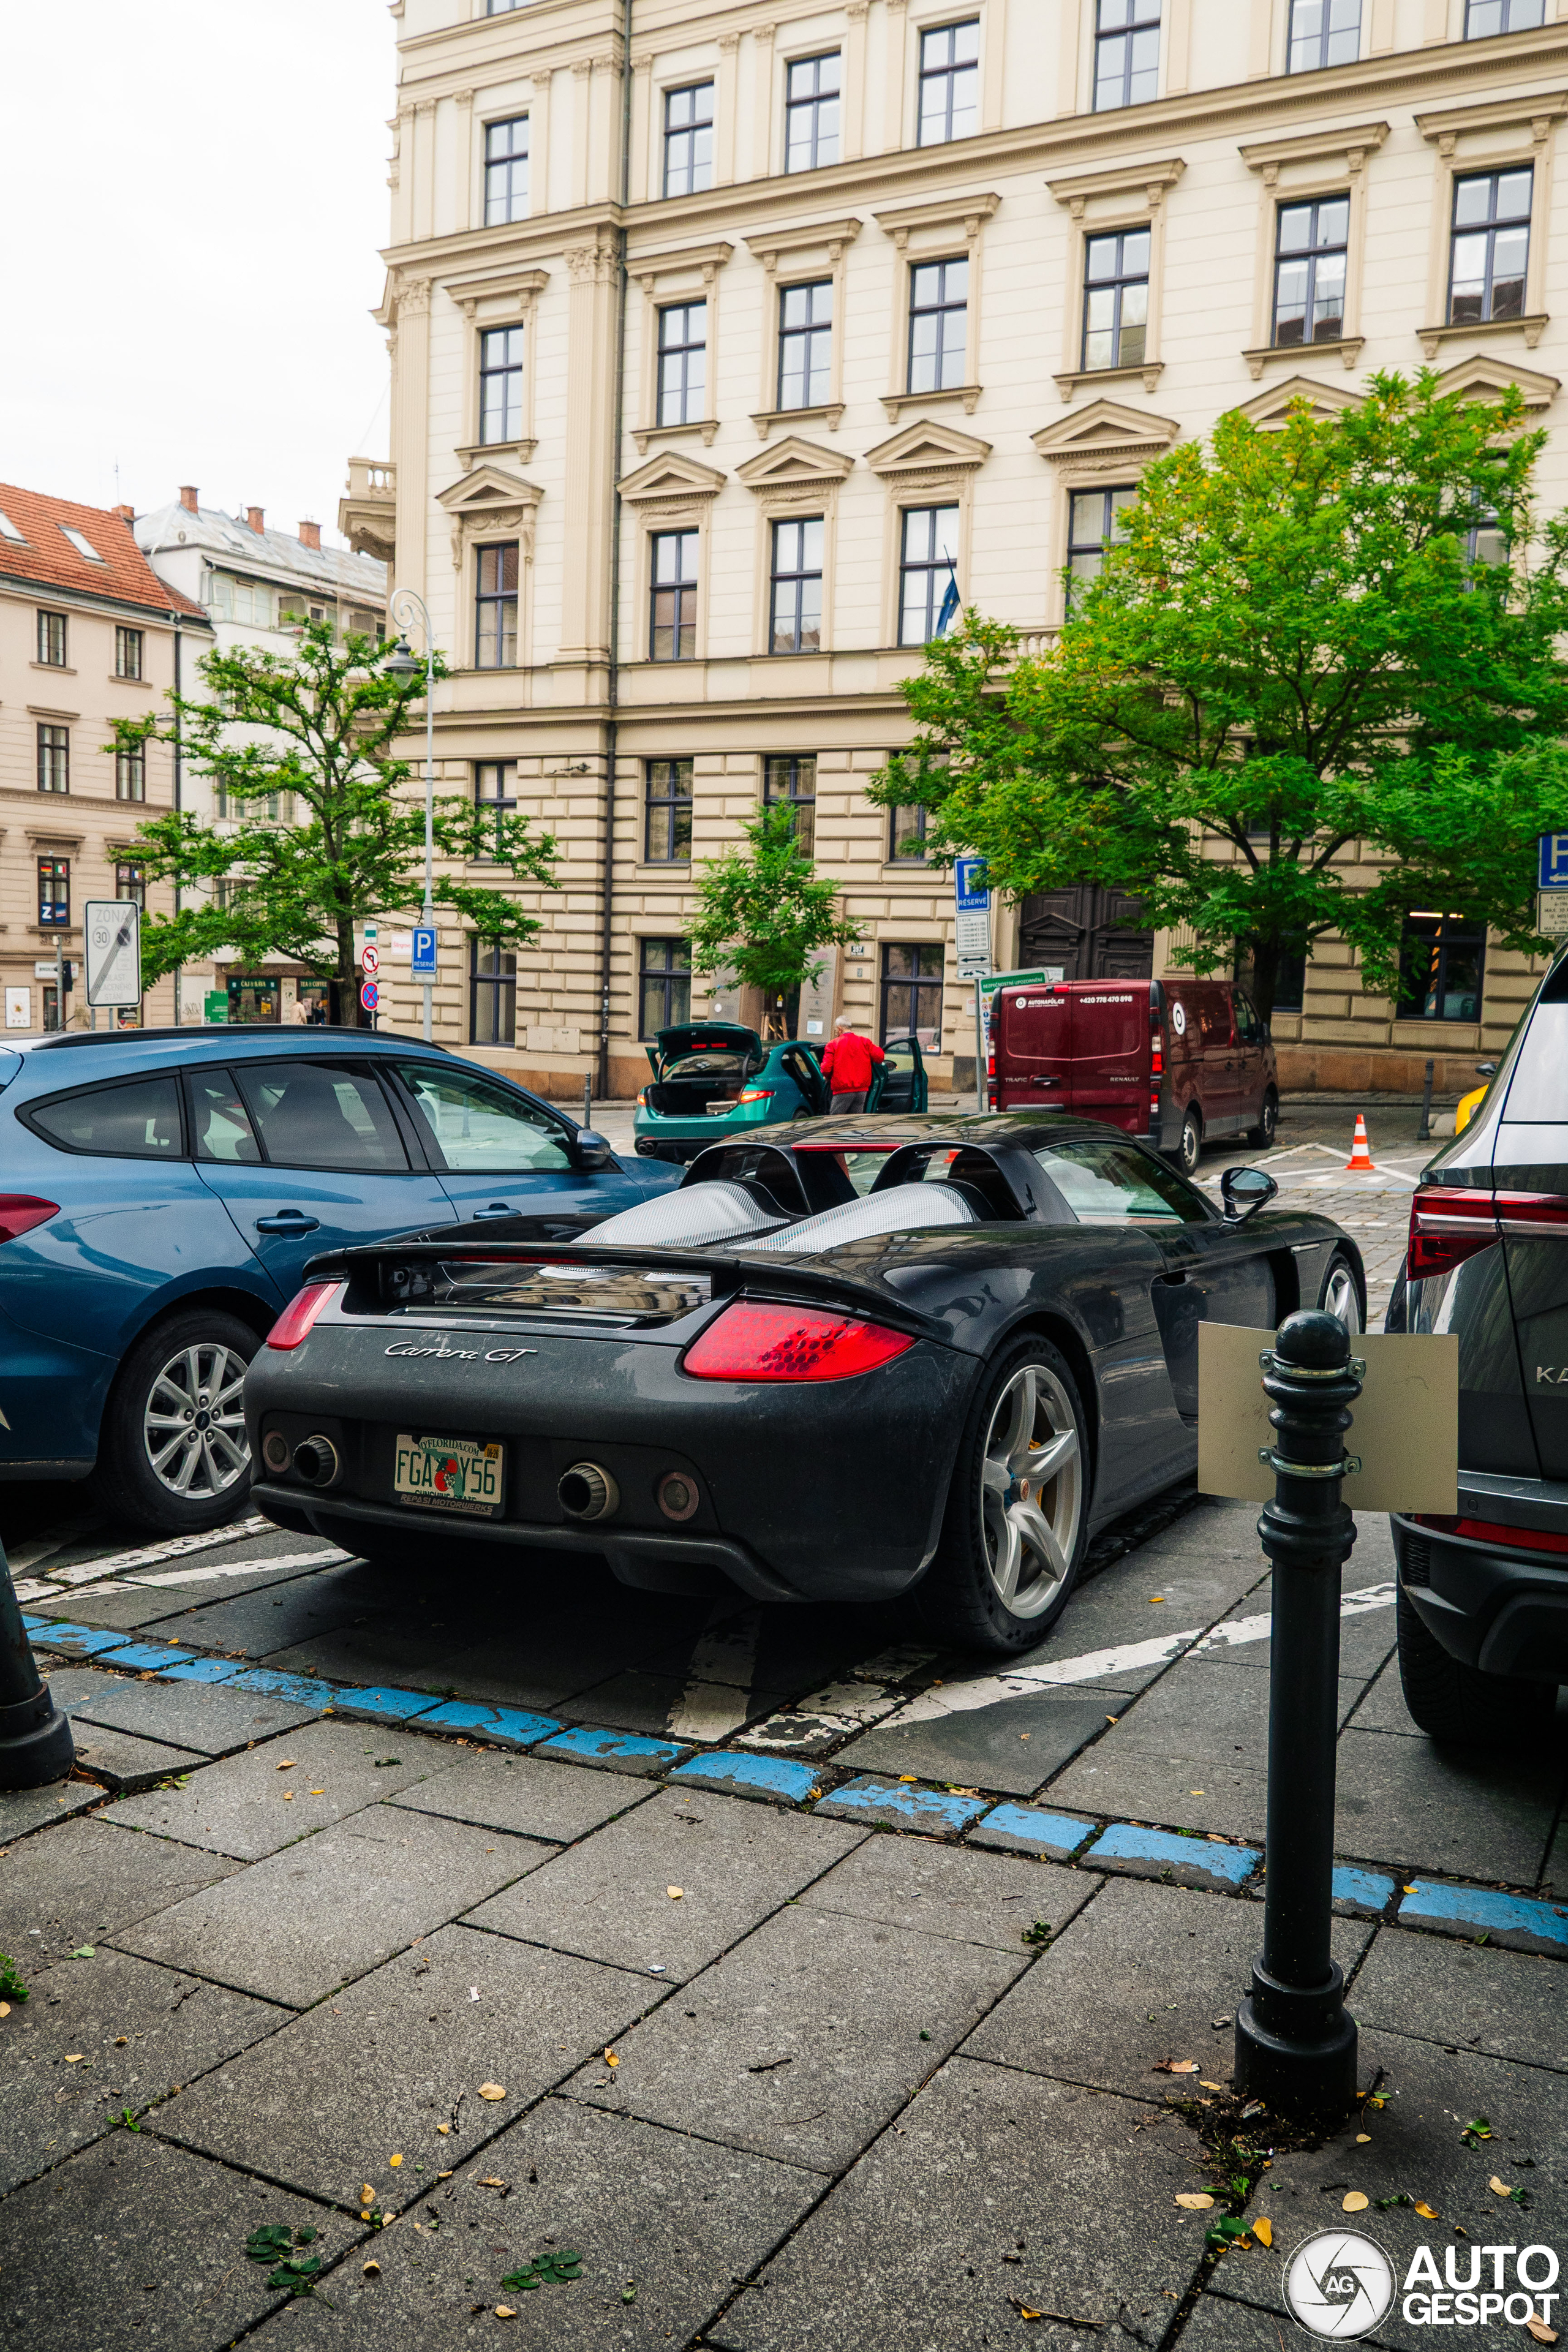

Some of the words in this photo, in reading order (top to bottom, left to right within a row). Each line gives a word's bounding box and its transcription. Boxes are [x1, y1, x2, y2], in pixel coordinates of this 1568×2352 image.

[959, 897, 987, 907] RÉSERVÉ
[96, 906, 127, 922] ZÓNA
[96, 932, 107, 943] 30
[418, 933, 431, 958] P
[1014, 977, 1042, 986] UPOZORNĚNÍ
[384, 1341, 479, 1360] Carrera
[484, 1348, 538, 1362] GT
[418, 1439, 481, 1457] MYFLORIDA.COM
[397, 1450, 432, 1487] FGA
[459, 1457, 496, 1494] Y56
[401, 1494, 431, 1504] REPASI
[432, 1498, 494, 1512] MOTORWERKS
